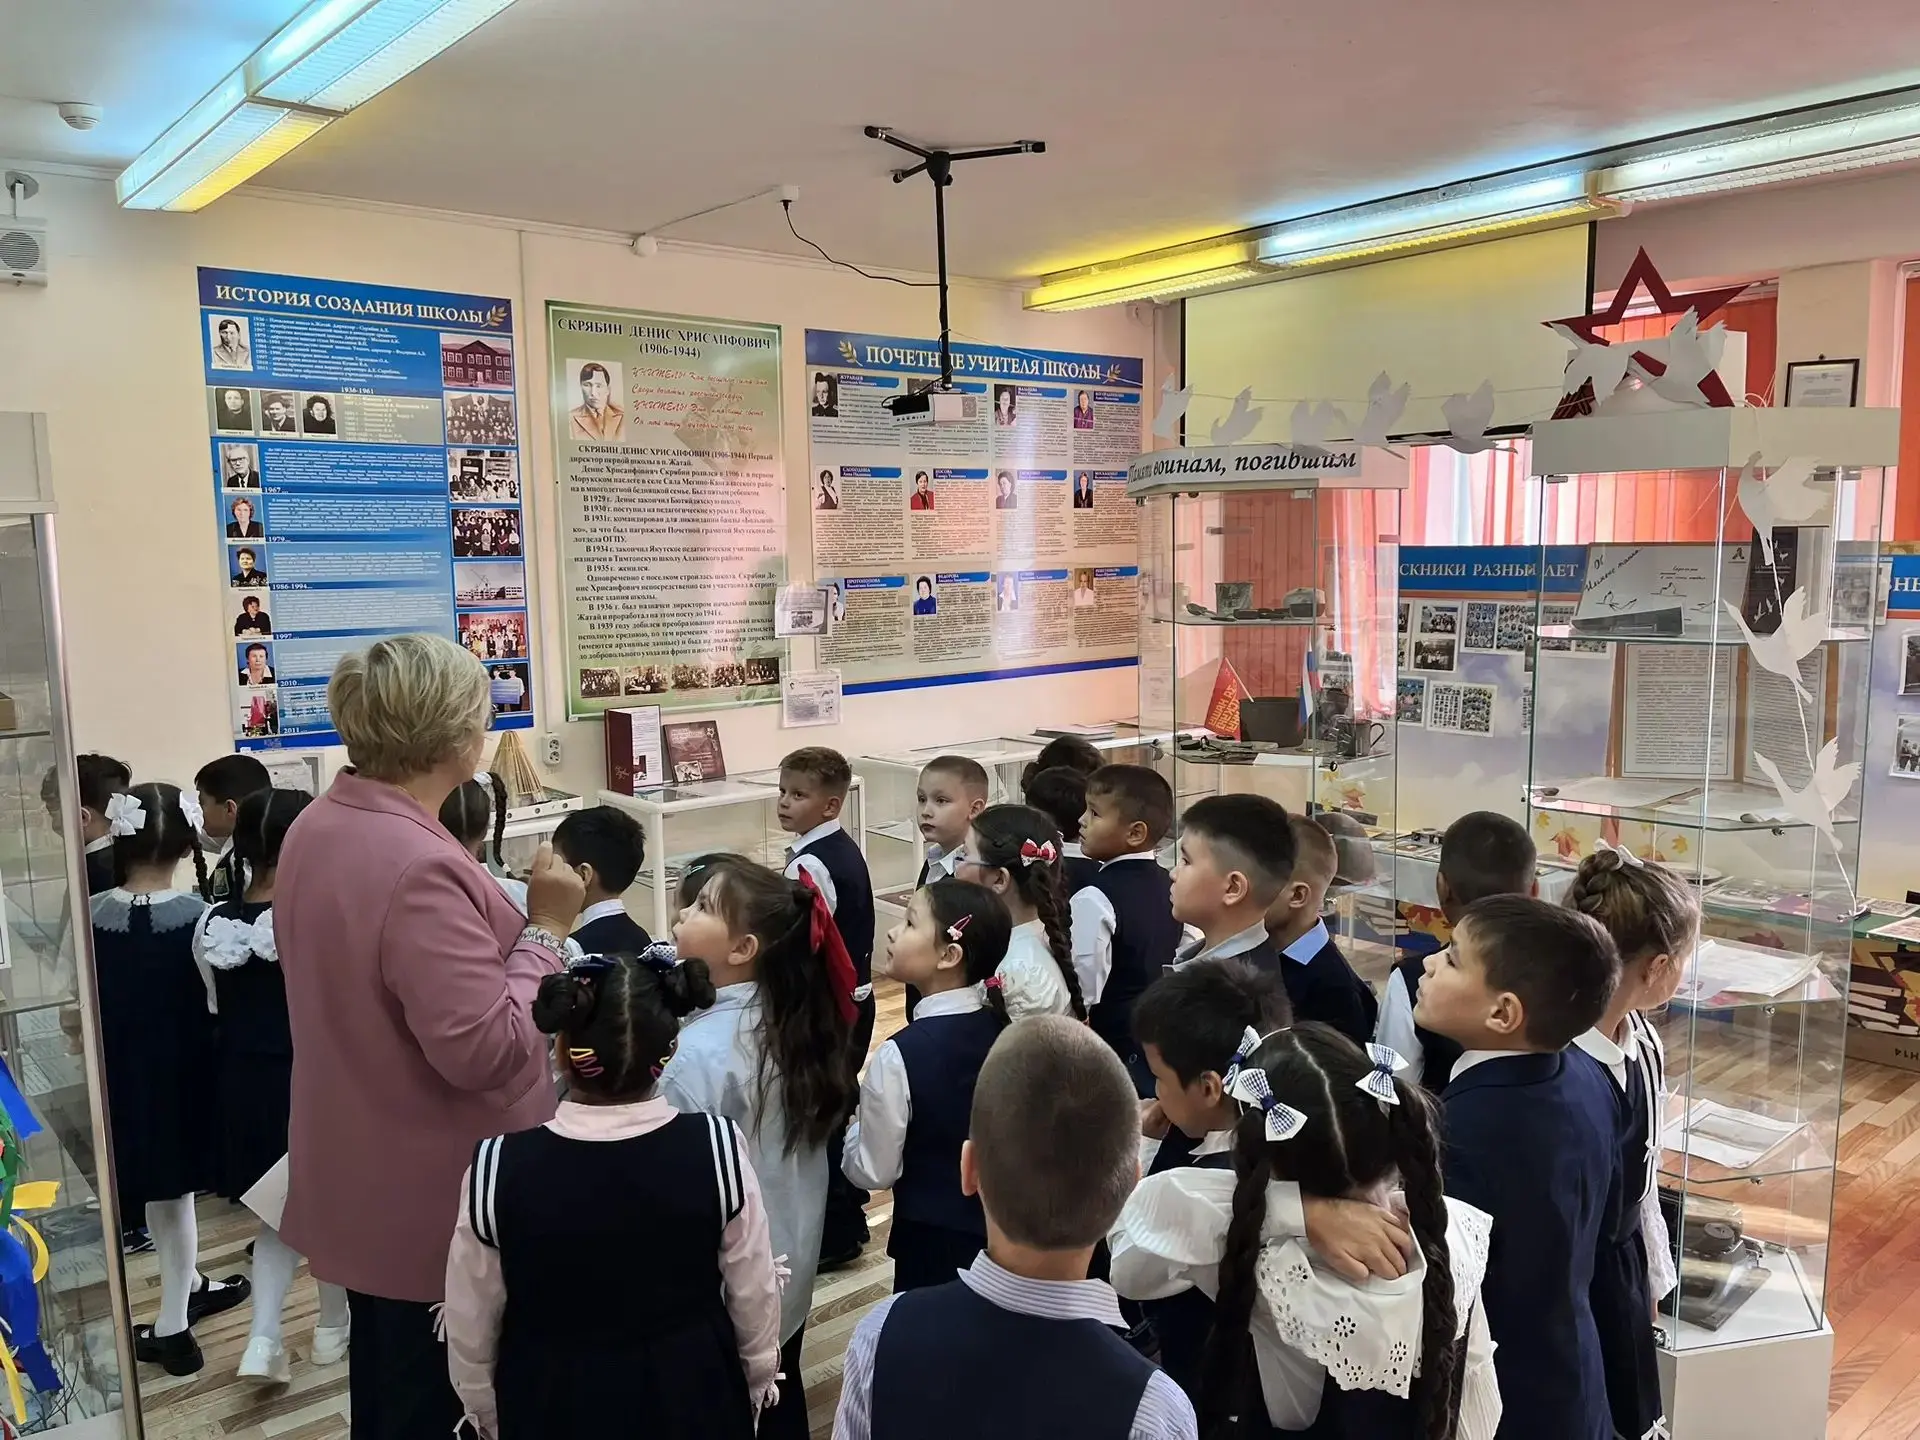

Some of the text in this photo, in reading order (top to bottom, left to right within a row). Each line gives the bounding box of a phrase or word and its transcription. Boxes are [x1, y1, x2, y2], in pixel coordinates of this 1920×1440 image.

[215, 284, 484, 325] ИСТОРИЯ СОЗДАНИЯ ШКОЛЫ
[558, 318, 771, 349] СКРЯБИН ДЕНИС ХРИСАНФОВИЧ
[639, 342, 701, 359] (1906-1944)
[865, 345, 1101, 380] ПОЧЕТНЕ УЧИТЕЛЯ ШКОЛЫ
[578, 445, 618, 454] СКРЯБИН
[620, 447, 649, 456] ДЕНИС
[650, 448, 710, 458] ХРИСАНФОВИЧ
[1153, 454, 1228, 476] воинам,
[1400, 563, 1467, 578] СКНИКИ
[1544, 563, 1579, 577] ЛЕТ
